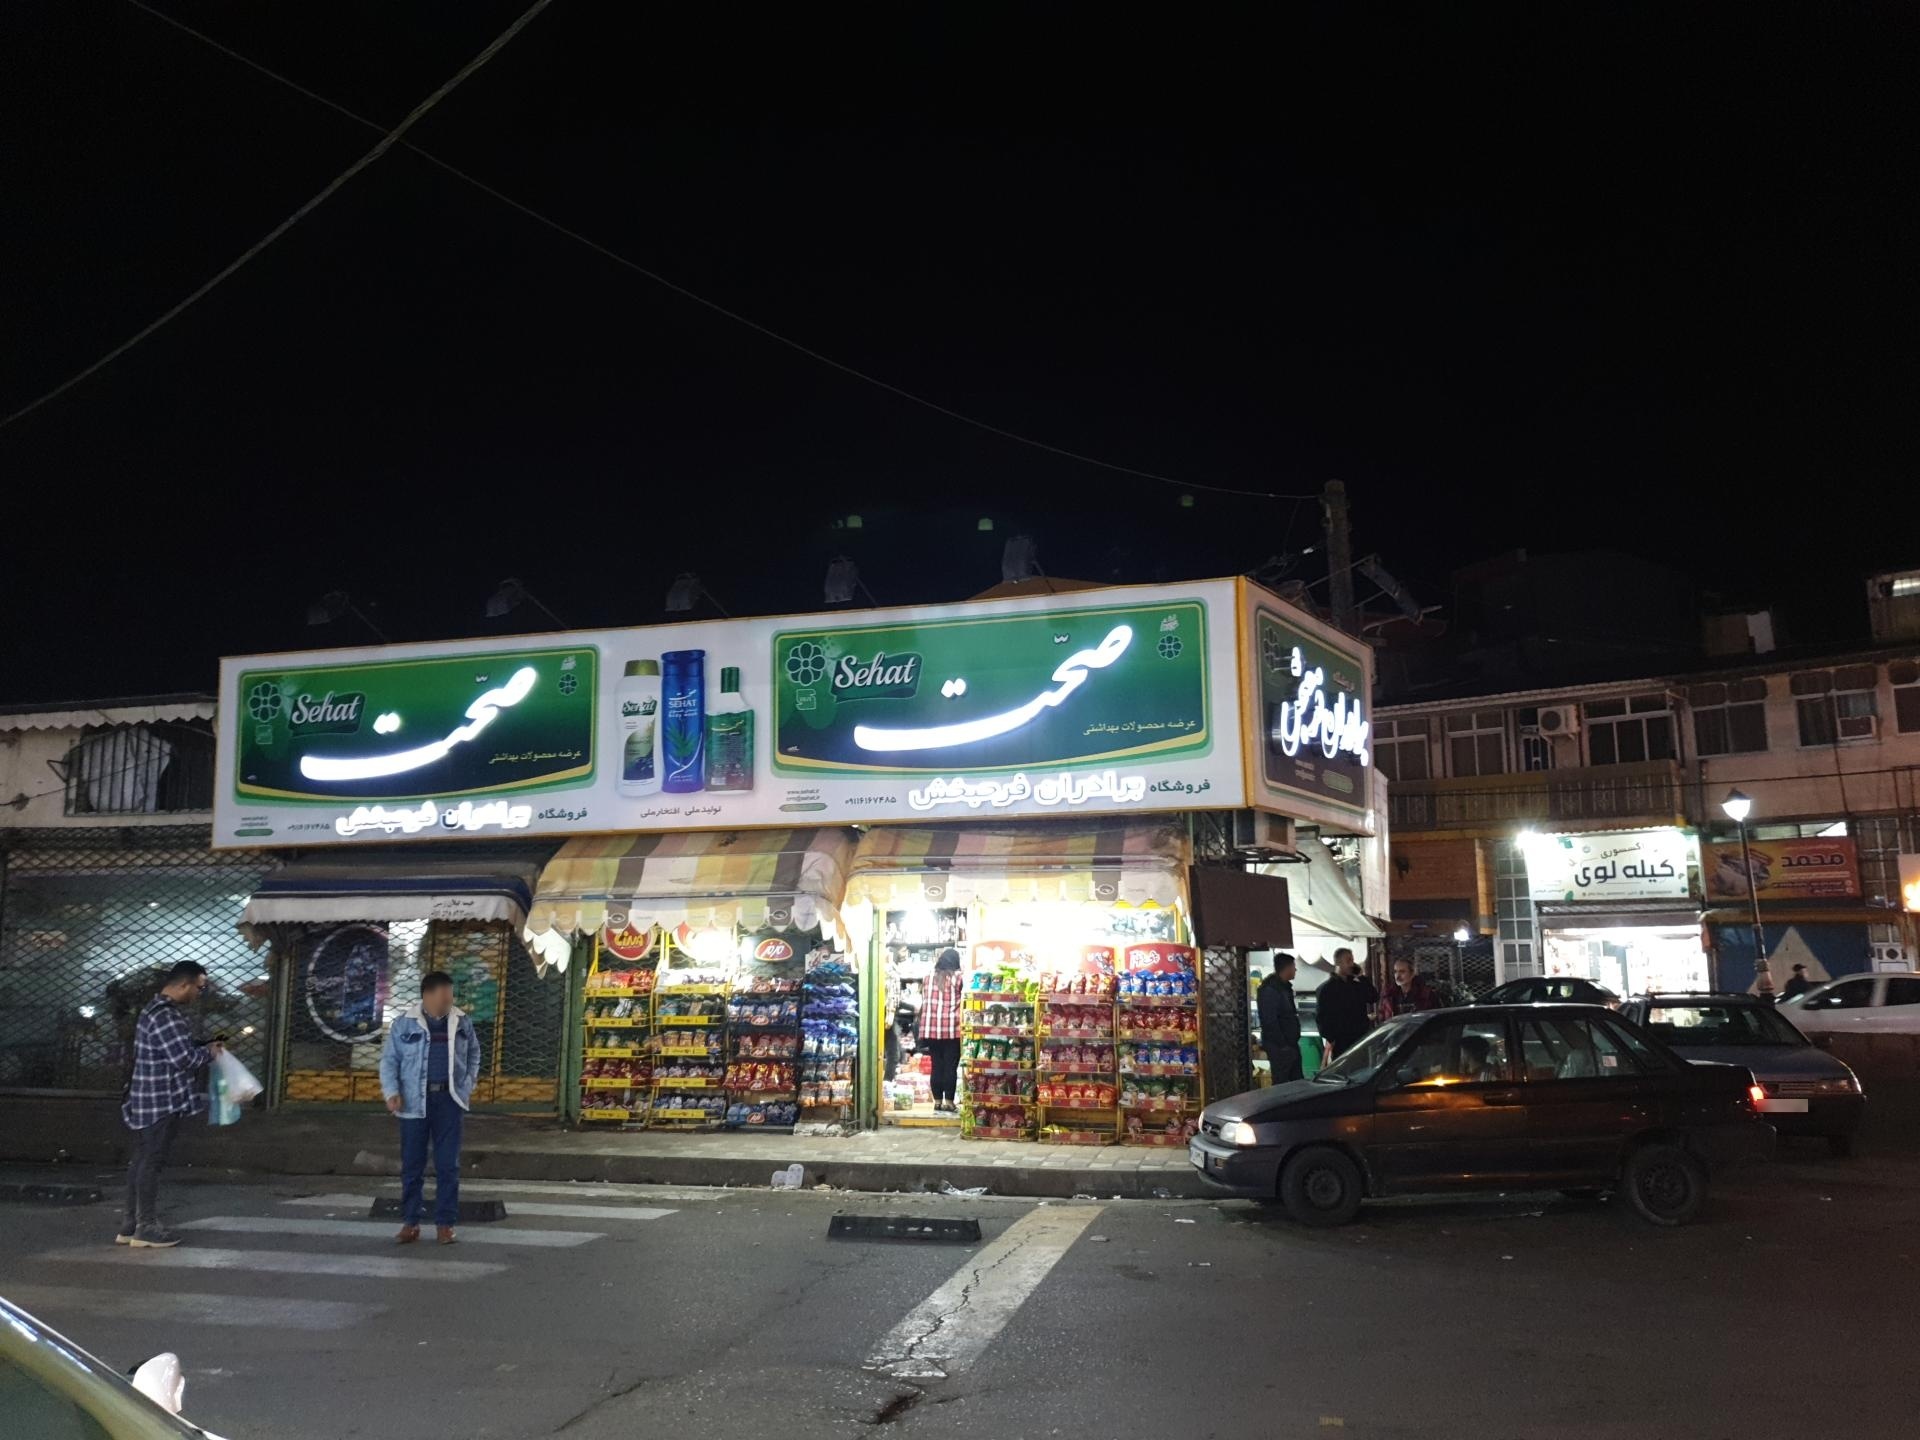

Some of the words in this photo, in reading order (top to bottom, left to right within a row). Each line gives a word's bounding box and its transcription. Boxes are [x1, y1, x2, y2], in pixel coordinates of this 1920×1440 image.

[835, 652, 916, 688] Sehat
[292, 691, 361, 724] Sehat
[668, 699, 697, 709] SEHAT
[1083, 723, 1119, 736] بهداشتی
[1121, 721, 1165, 733] محصولات
[1167, 718, 1196, 731] عرضه
[488, 752, 519, 764] بهداشتی
[520, 751, 556, 761] محصولات
[560, 748, 582, 759] عرضه
[908, 772, 1032, 811] فرحبخش
[1033, 770, 1147, 805] برادران
[1149, 778, 1211, 794] فروشگاه
[537, 807, 588, 821] فروشگاه
[1781, 853, 1846, 868] محمد
[1575, 860, 1617, 888] لوی
[1622, 859, 1675, 883] کیله
